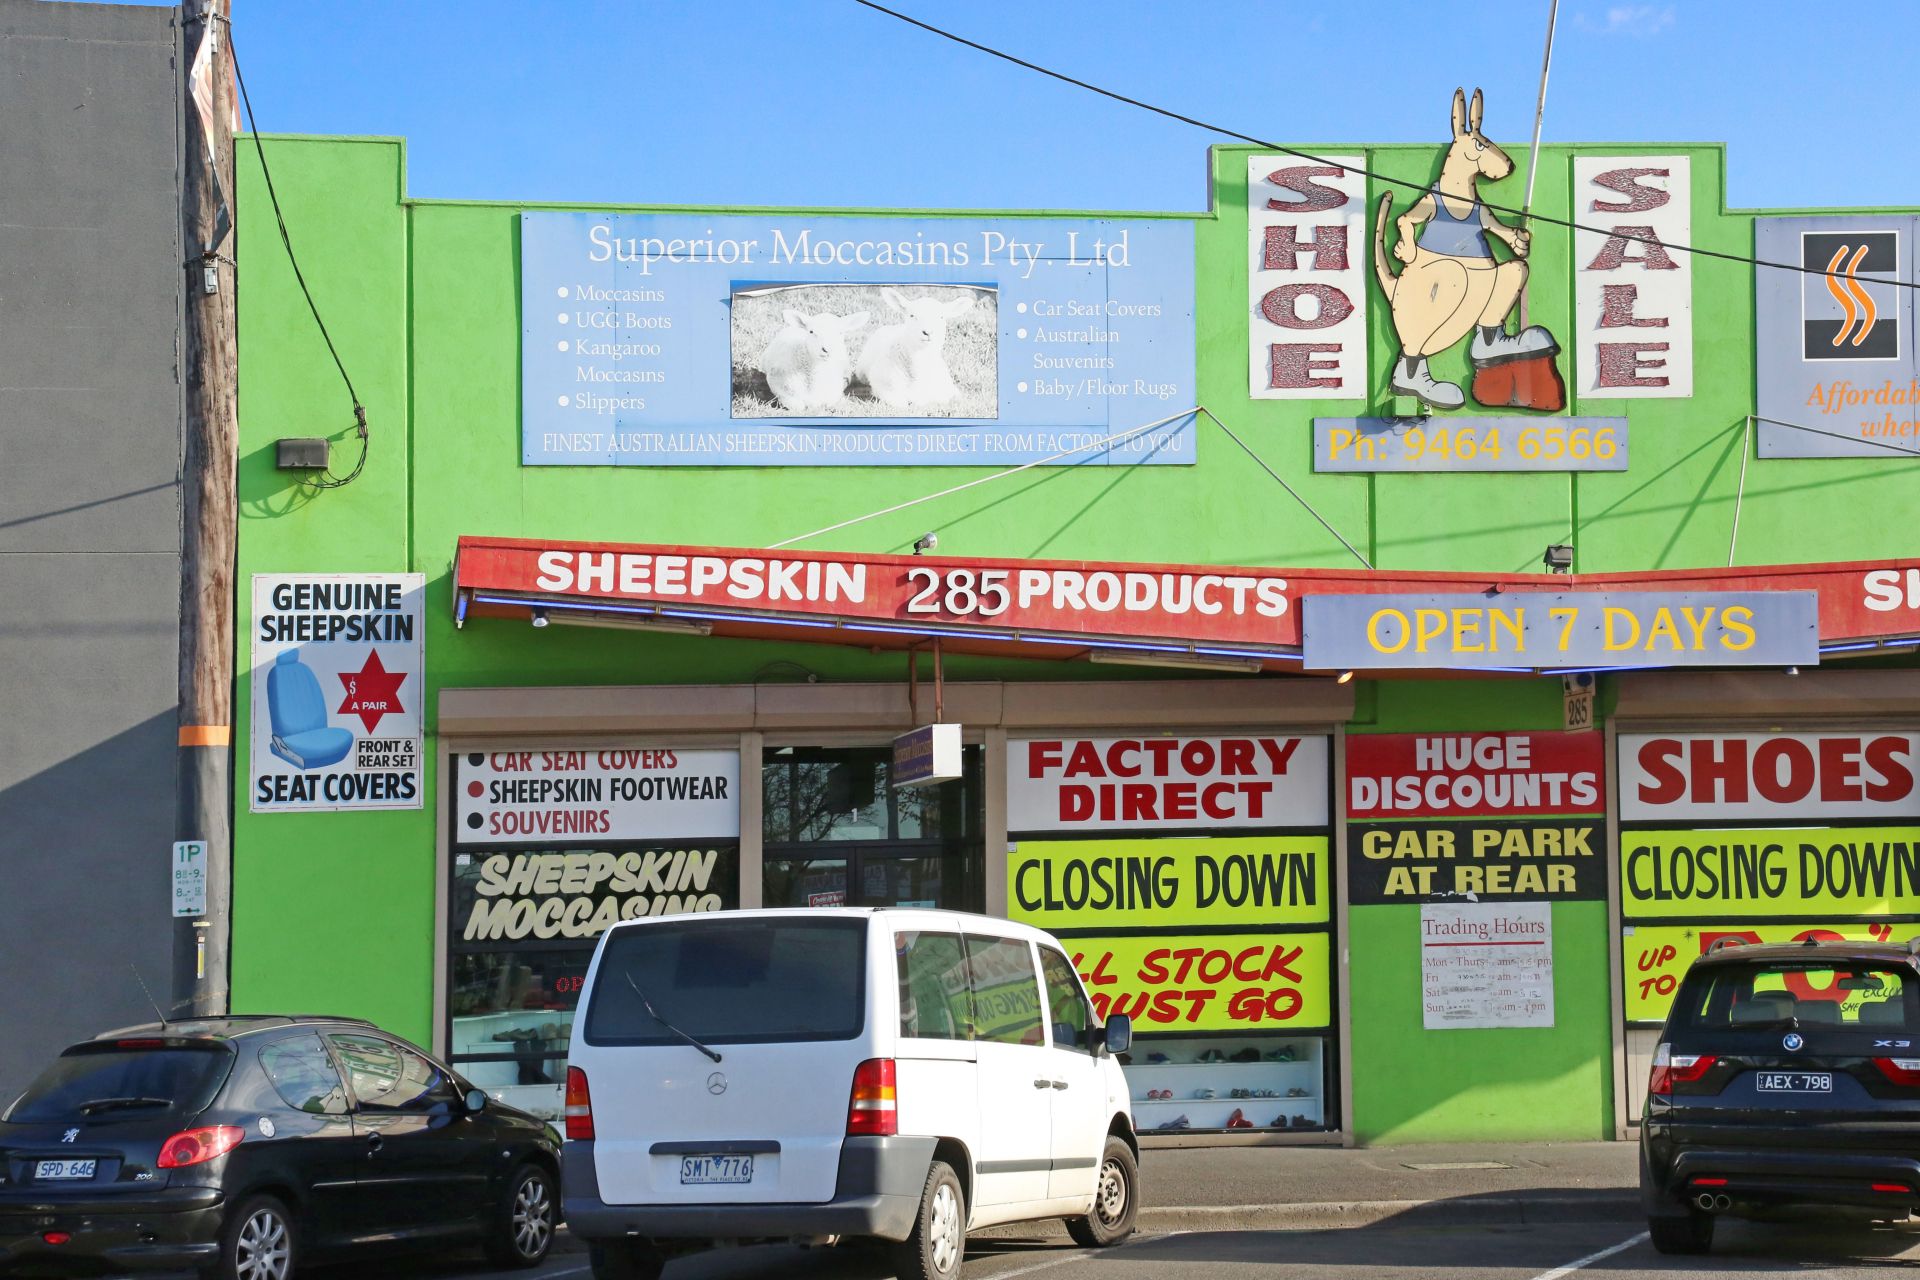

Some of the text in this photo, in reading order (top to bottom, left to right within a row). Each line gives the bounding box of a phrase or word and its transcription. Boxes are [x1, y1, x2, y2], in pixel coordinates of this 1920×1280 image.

[589, 225, 1131, 279] Superior Moccasins Pty. Ltd
[1261, 166, 1355, 389] SHOE
[1587, 167, 1681, 388] SALE
[575, 285, 665, 302] Moccasins
[575, 311, 672, 329] UGG Boots
[1033, 300, 1161, 317] Car Seat Covers
[1033, 325, 1120, 343] Australian
[575, 338, 661, 361] Kangaroo
[1033, 353, 1114, 369] Souvenirs
[575, 366, 665, 383] Moccasins
[1134, 380, 1177, 399] Rugs
[575, 392, 645, 414] Slippers
[543, 432, 1184, 452] FINEST AUSTRALIAN SHEEPSKIN PRODUCTS DIRECT FROM FACTORY TO YOU
[1328, 428, 1617, 461] Ph: 9464 6566
[272, 583, 402, 611] GENUINE
[536, 551, 1288, 617] SHEEPSKIN 285 PRODUCTS
[260, 614, 414, 641] SHEEPSKIN
[1366, 606, 1756, 653] OPEN 7 DAYS
[349, 676, 356, 699] $
[351, 701, 387, 710] A PAIR
[1568, 697, 1588, 726] 285
[358, 740, 414, 753] FRONT &
[1028, 738, 1302, 779] FACTORY
[1415, 736, 1531, 771] HUGE
[358, 754, 416, 767] REAR SET
[490, 752, 533, 773] CAR
[597, 750, 678, 770] COVERS
[1637, 736, 1914, 805] SHOES
[257, 772, 416, 802] SEAT COVERS
[489, 776, 728, 804] SHEEPSKIN FOOTWEAR
[1351, 772, 1598, 810] DISCOUNTS
[1059, 782, 1273, 821] DIRECT
[489, 809, 610, 835] SOUVENIRS
[179, 844, 201, 862] 1P
[1362, 827, 1594, 859] CAR PARK
[475, 850, 718, 896] SHEEPSKIN
[1015, 852, 1317, 912] CLOSING DOWN
[1384, 864, 1577, 895] AT REAR
[1627, 842, 1920, 900] CLOSING DOWN
[1423, 917, 1545, 940] Trading Hours
[1137, 944, 1304, 985] STOCK
[1425, 957, 1447, 967] Mon
[1456, 956, 1485, 967] Thurs
[1637, 945, 1676, 971] UP
[556, 976, 585, 992] OP
[1425, 972, 1439, 982] Fri
[1639, 974, 1677, 1000] TO
[1228, 987, 1302, 1022] GO
[1425, 987, 1440, 997] Sat
[1426, 1003, 1444, 1012] Sun
[1764, 1075, 1830, 1089] AEX 798
[40, 1162, 94, 1176] SPD 646
[684, 1159, 749, 1176] SMT 776
